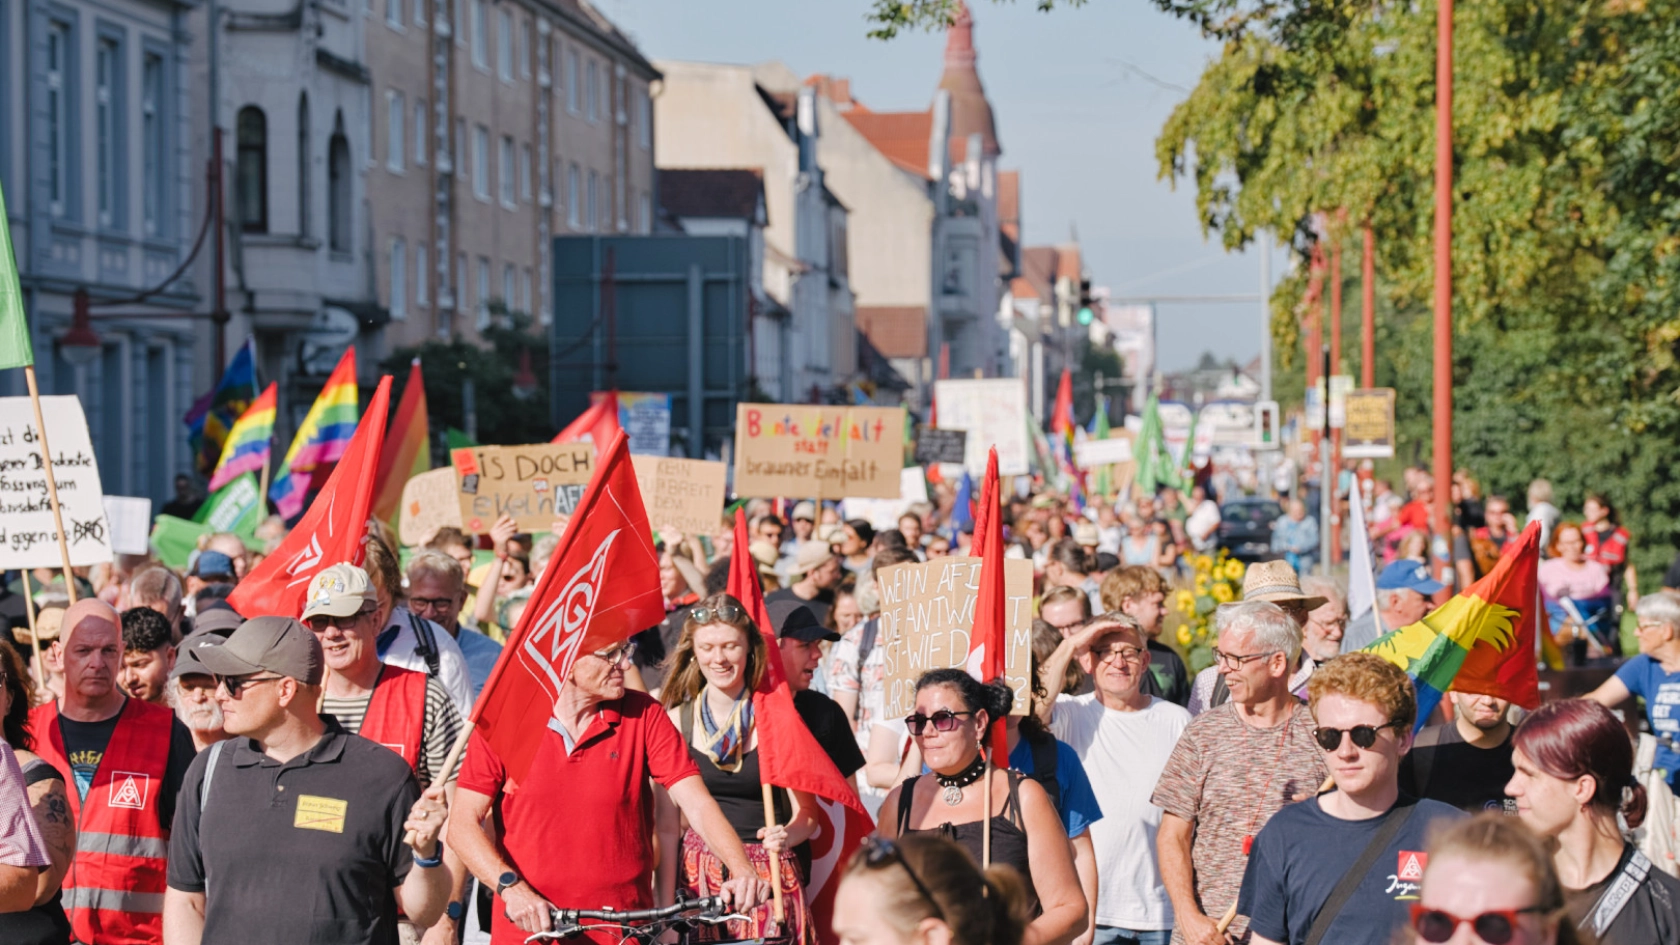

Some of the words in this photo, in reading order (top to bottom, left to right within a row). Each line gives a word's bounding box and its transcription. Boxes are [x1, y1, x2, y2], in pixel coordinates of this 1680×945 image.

[746, 409, 799, 438] Bunte
[804, 412, 885, 452] Vielfalt
[515, 451, 589, 482] DOCH
[745, 456, 810, 476] brauner
[813, 459, 878, 488] Einfalt
